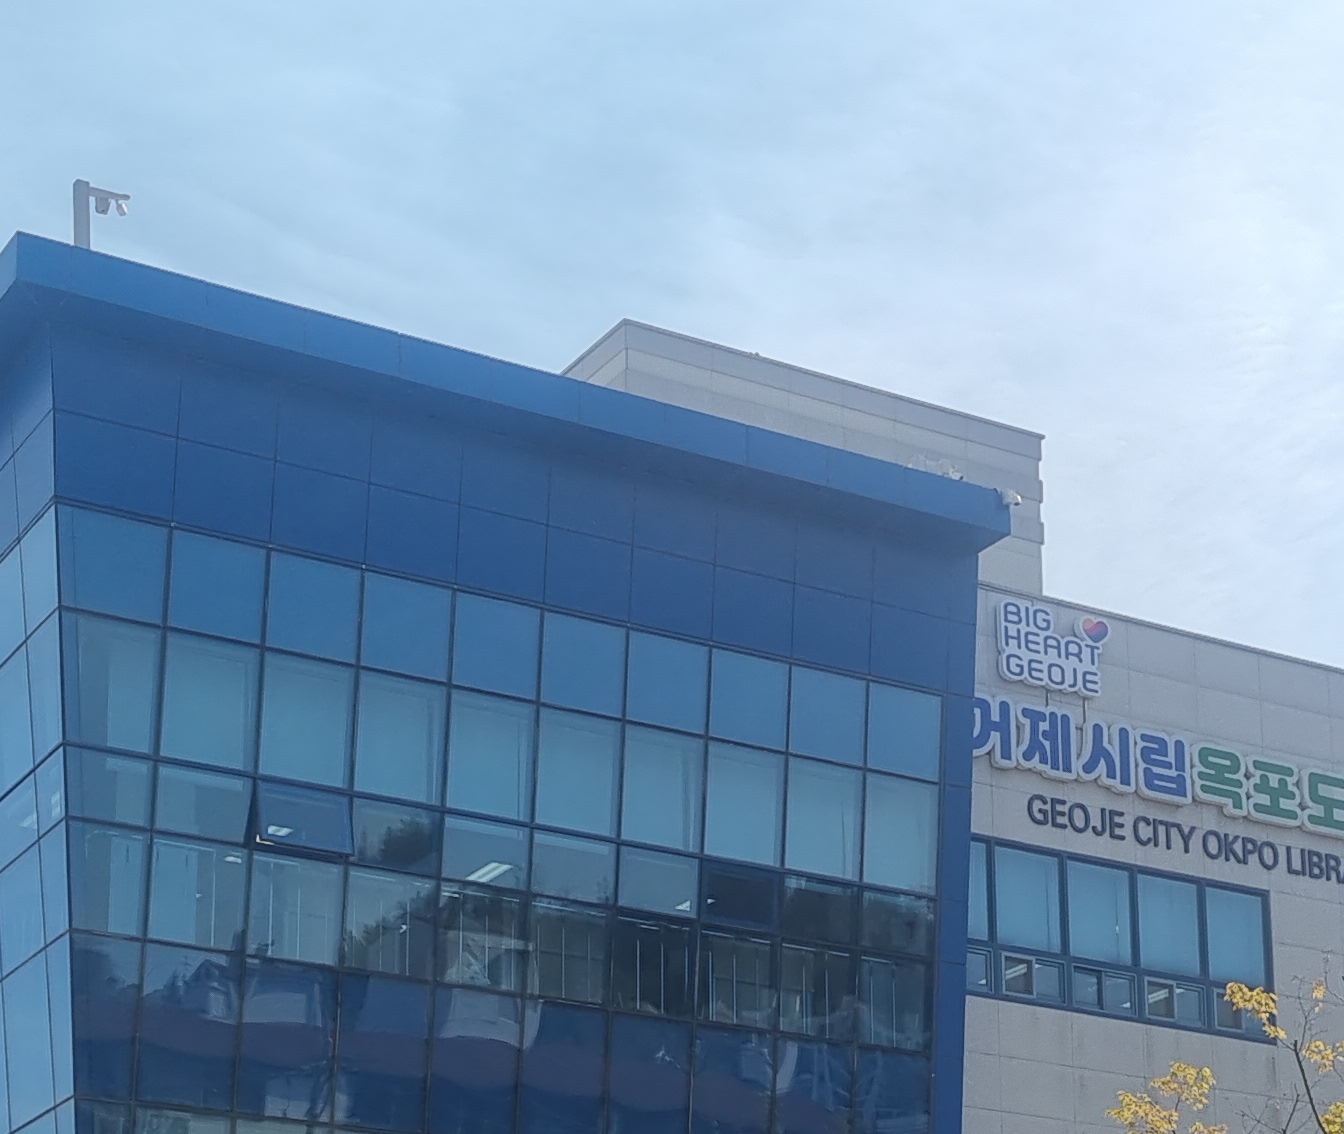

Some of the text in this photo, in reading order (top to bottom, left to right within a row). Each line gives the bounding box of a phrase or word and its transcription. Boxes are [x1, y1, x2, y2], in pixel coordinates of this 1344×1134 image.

[1002, 601, 1051, 633] BIG
[1003, 627, 1101, 666] HEART
[1004, 653, 1101, 694] GEOJE
[1027, 793, 1126, 841] GEOJE
[1132, 815, 1197, 853] CITY
[1202, 829, 1279, 871] OKPO
